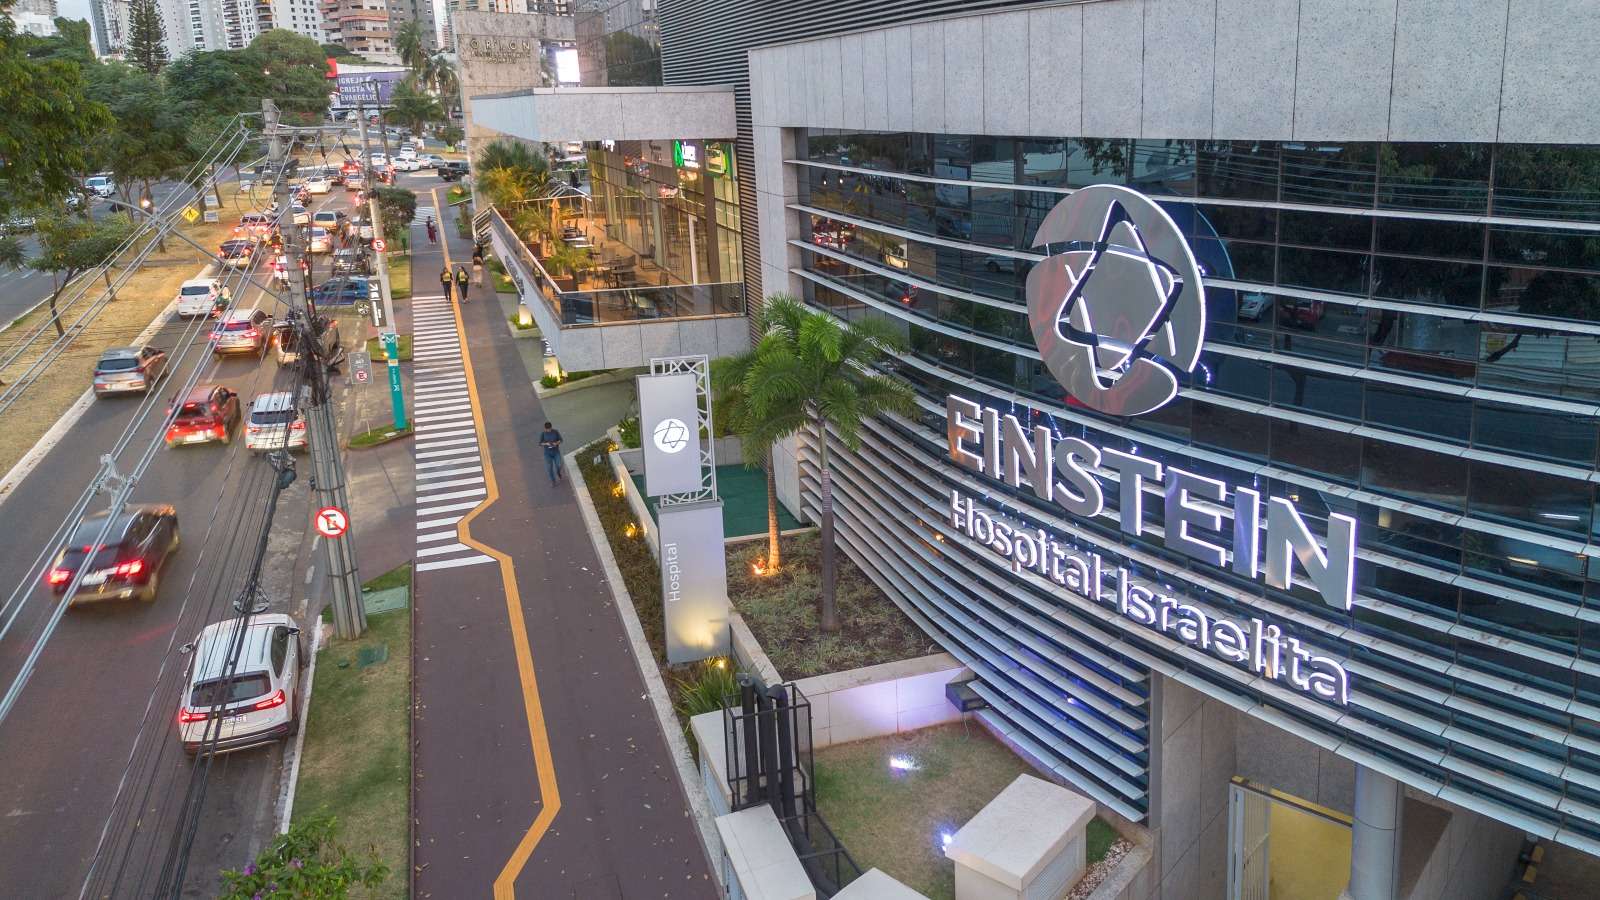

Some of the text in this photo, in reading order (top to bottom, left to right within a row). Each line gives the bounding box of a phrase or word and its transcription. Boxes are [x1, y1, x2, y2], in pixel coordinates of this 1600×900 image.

[664, 543, 680, 601] Hospital
[947, 394, 1356, 609] EINSTEIN
[951, 490, 1348, 704] Hospital Israelita
